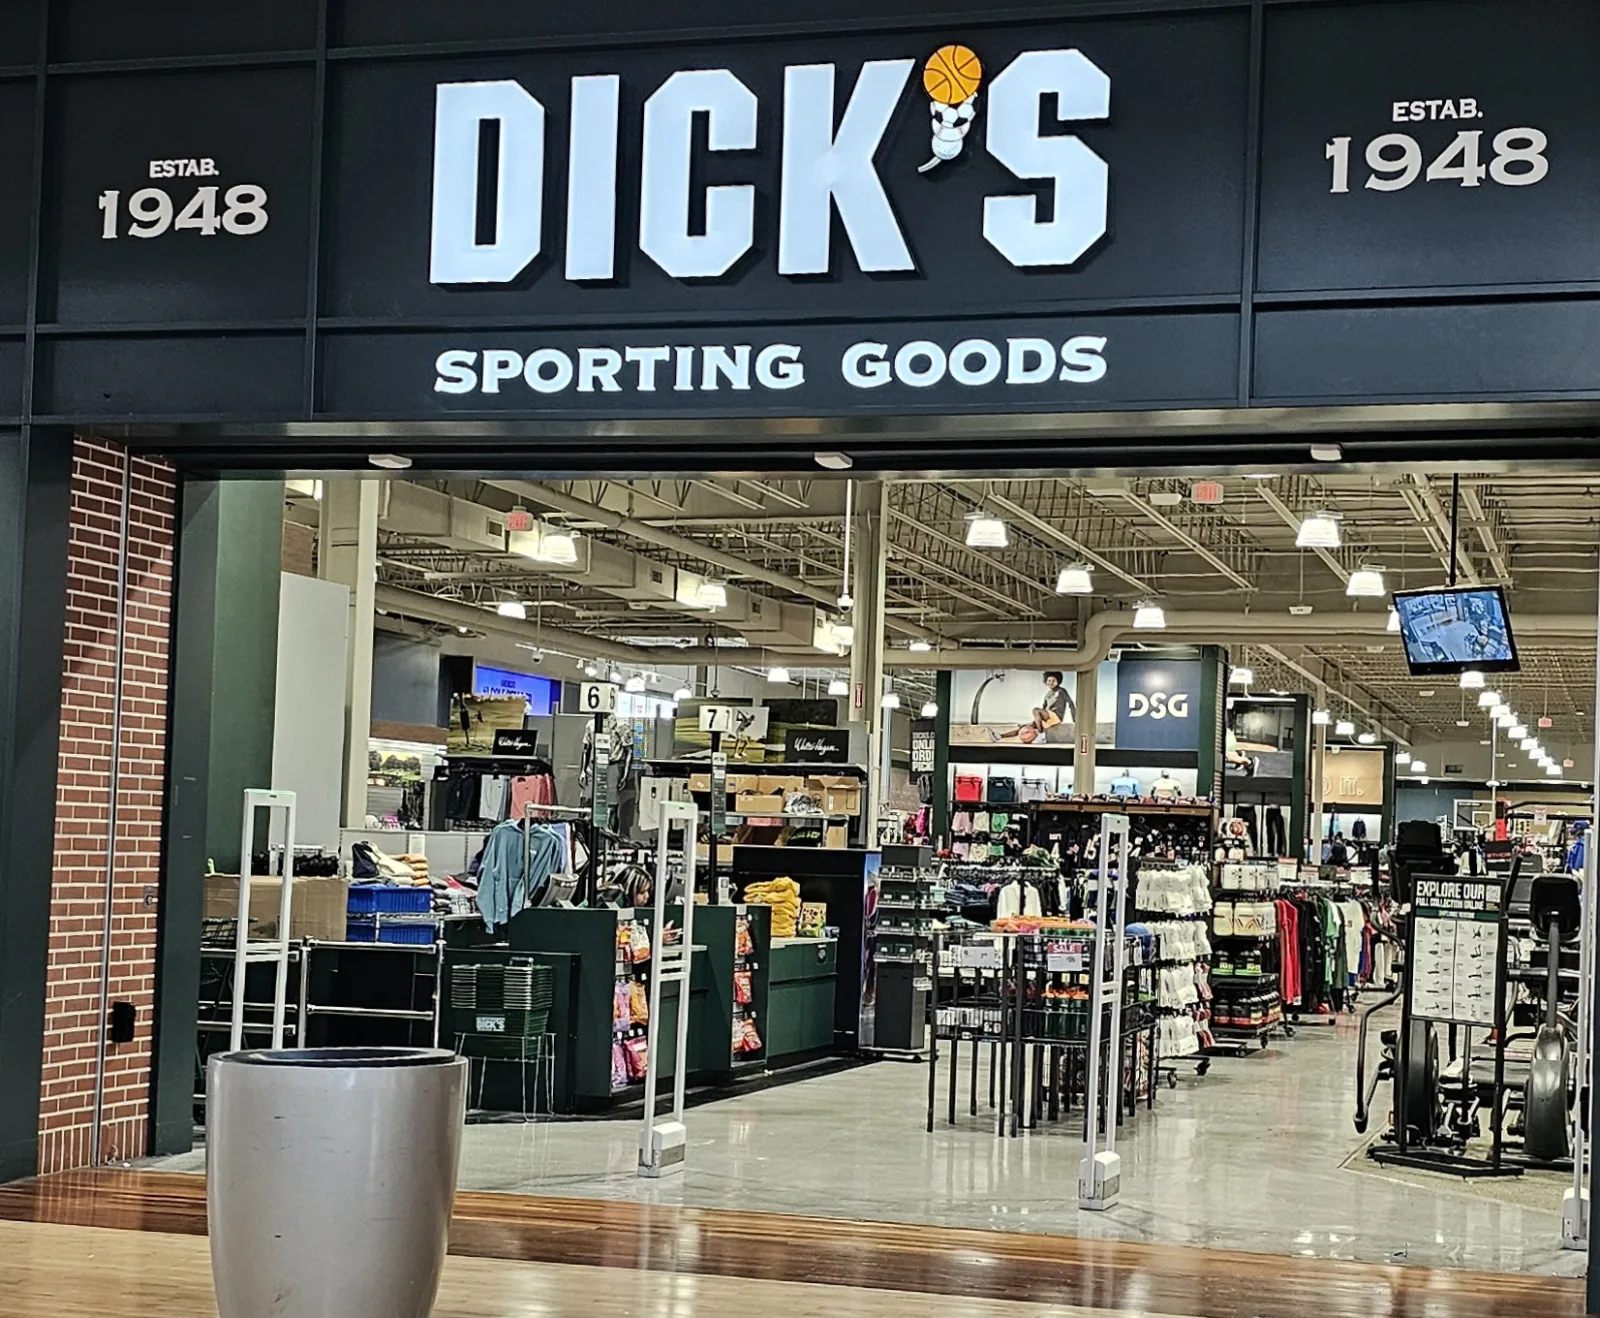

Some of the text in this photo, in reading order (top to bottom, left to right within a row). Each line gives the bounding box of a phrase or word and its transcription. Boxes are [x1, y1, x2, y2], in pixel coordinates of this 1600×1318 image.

[1393, 98, 1483, 122] ESTAB.
[149, 158, 220, 178] ESTAB.
[429, 44, 1111, 284] DICK'S
[1325, 127, 1549, 193] 1948
[98, 184, 269, 239] 1948
[433, 336, 1109, 394] SPORTING GOODS
[588, 686, 599, 709] 6
[1128, 692, 1188, 719] DSG
[707, 709, 717, 729] 7
[1416, 881, 1485, 900] EXPLORE OUR
[1415, 897, 1429, 906] FULL
[1430, 898, 1463, 909] COLLECTION
[1053, 944, 1075, 953] SALE
